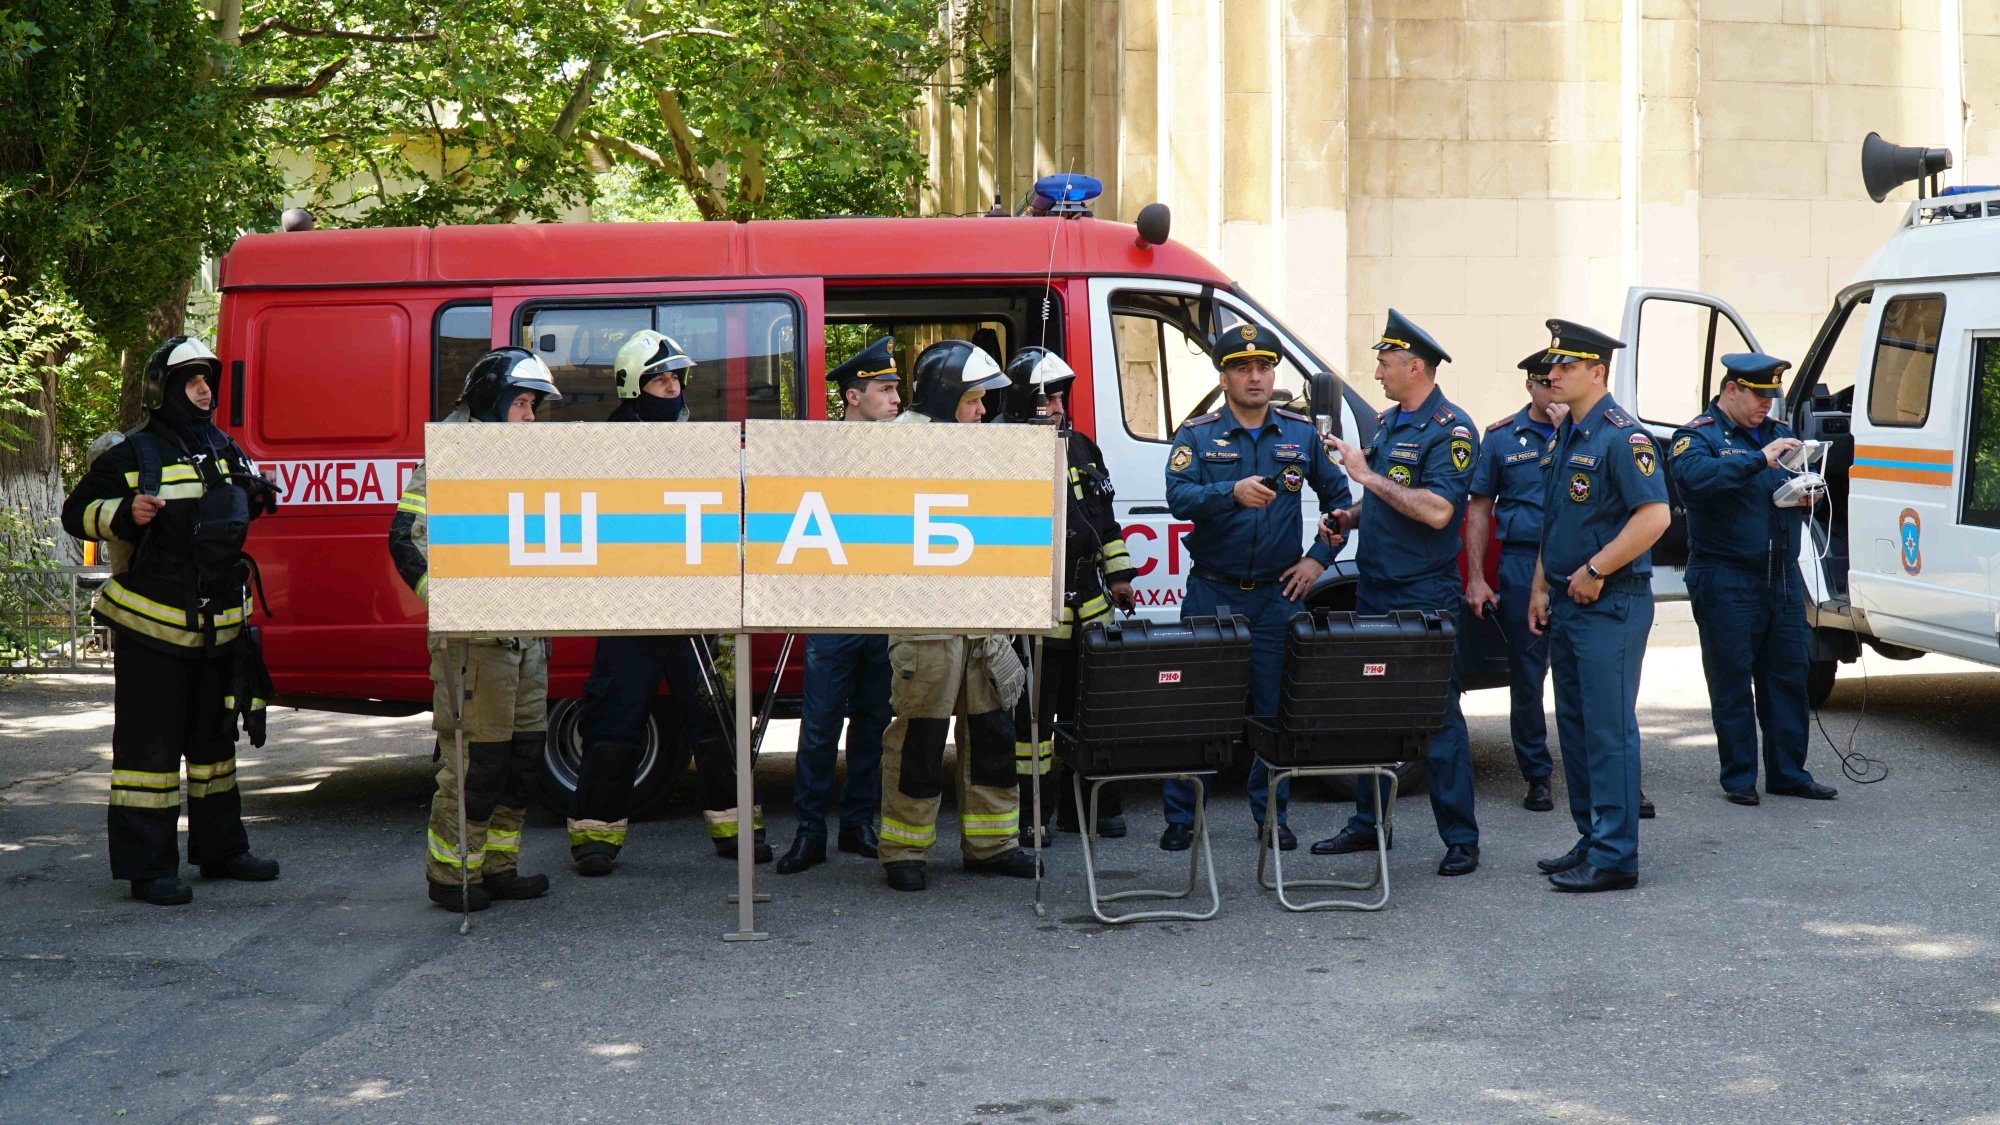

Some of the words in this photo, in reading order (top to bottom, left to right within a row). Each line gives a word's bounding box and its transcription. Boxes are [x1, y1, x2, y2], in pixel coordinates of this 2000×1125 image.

[258, 462, 385, 503] УЖБА
[508, 491, 975, 567] ШТАБ
[1134, 588, 1186, 606] АХАЧ
[1160, 672, 1179, 682] РИФ
[1365, 665, 1385, 675] РИФ
